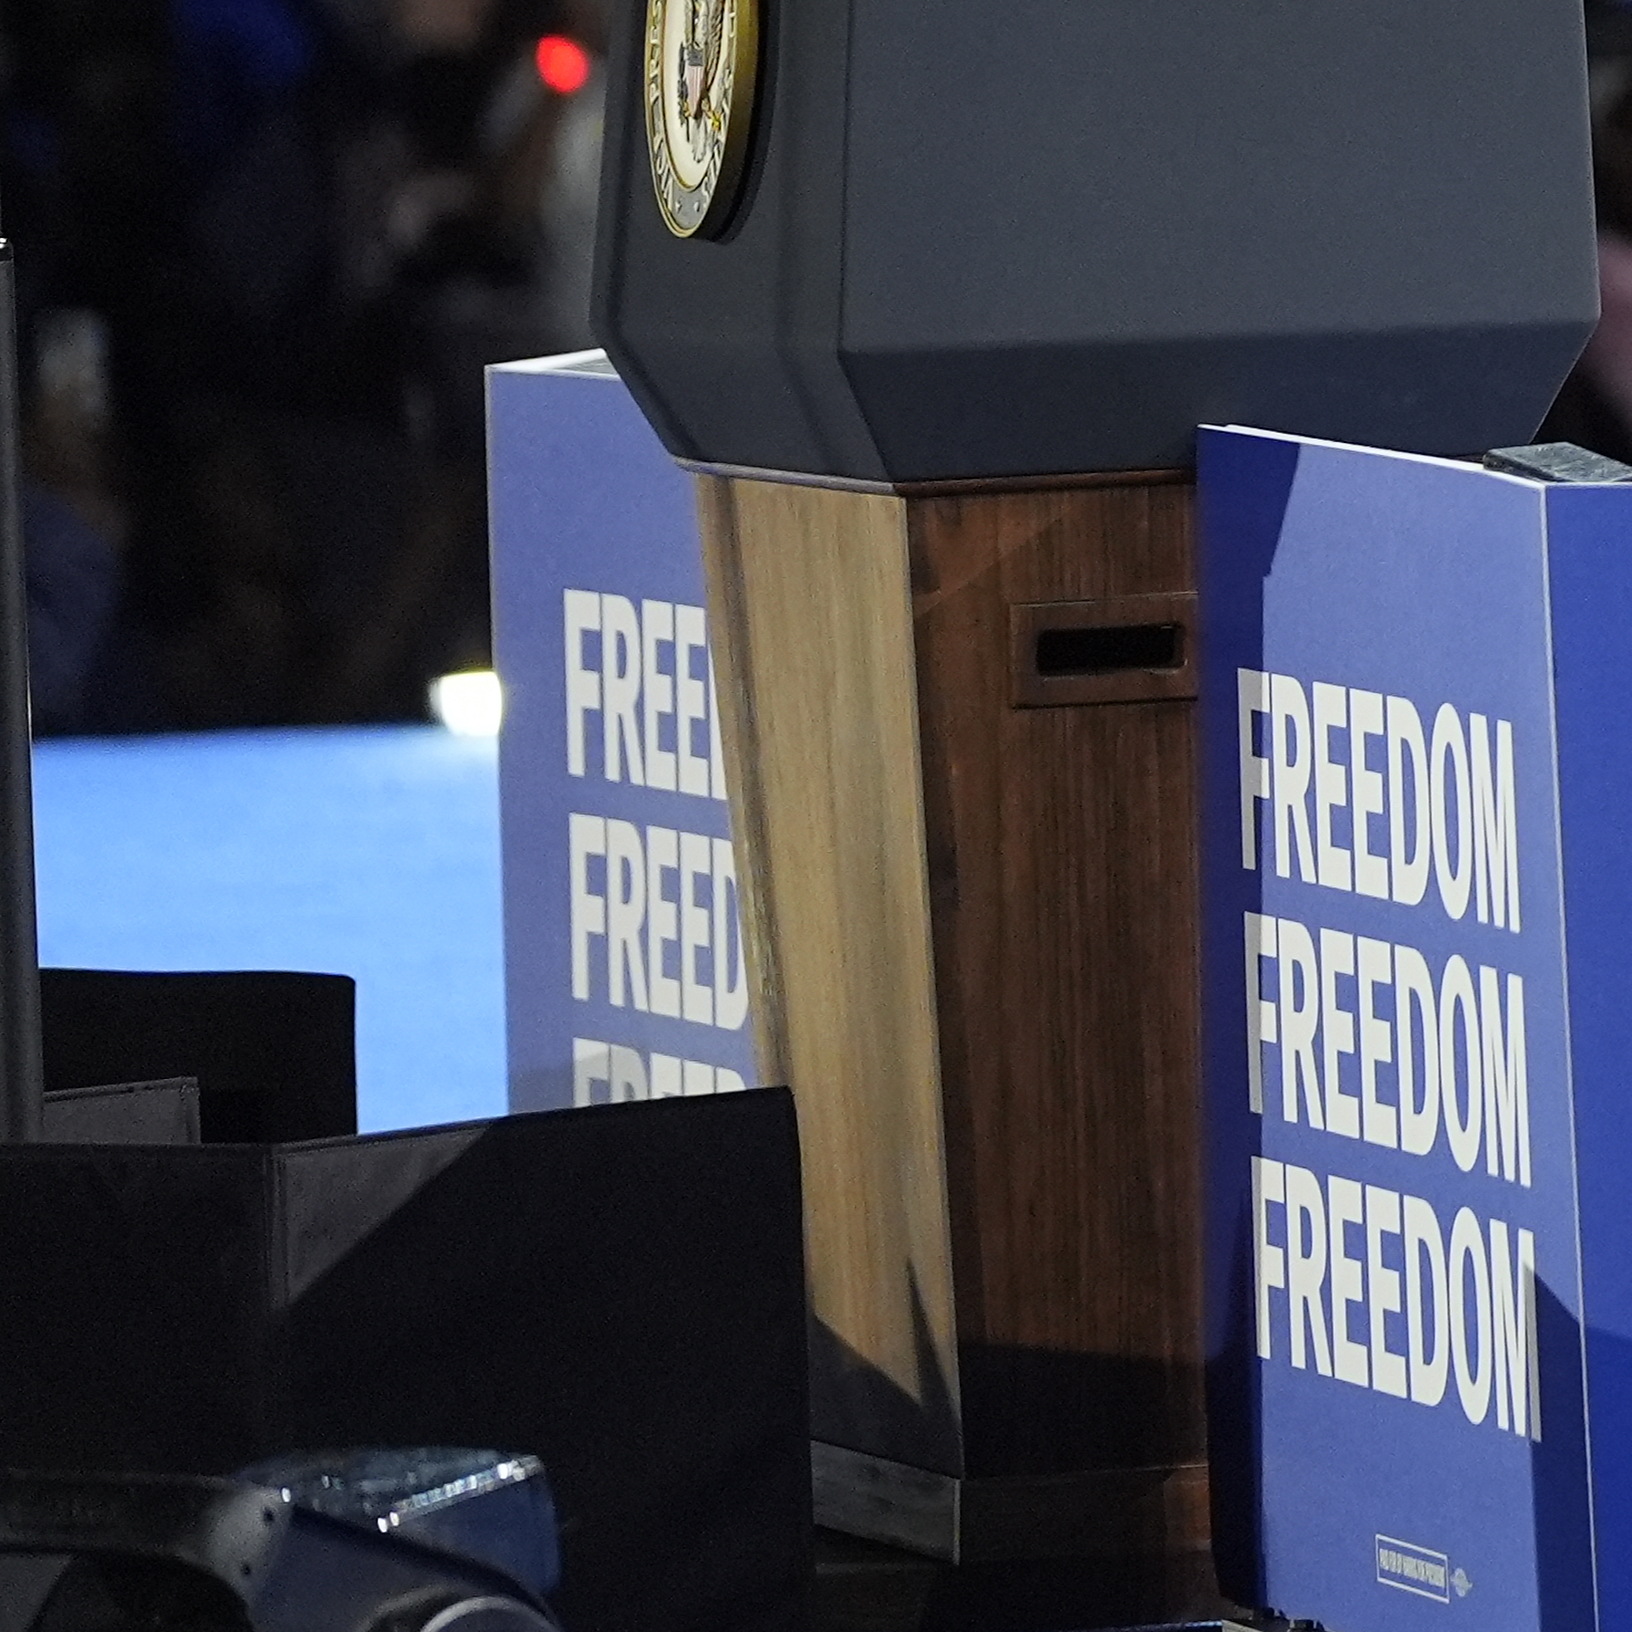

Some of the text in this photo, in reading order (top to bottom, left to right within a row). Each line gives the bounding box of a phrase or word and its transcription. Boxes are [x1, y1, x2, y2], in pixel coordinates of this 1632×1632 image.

[1237, 667, 1521, 934] FREEDOM
[1244, 911, 1532, 1188] FREEDOM
[1251, 1155, 1542, 1442] FREEDOM
